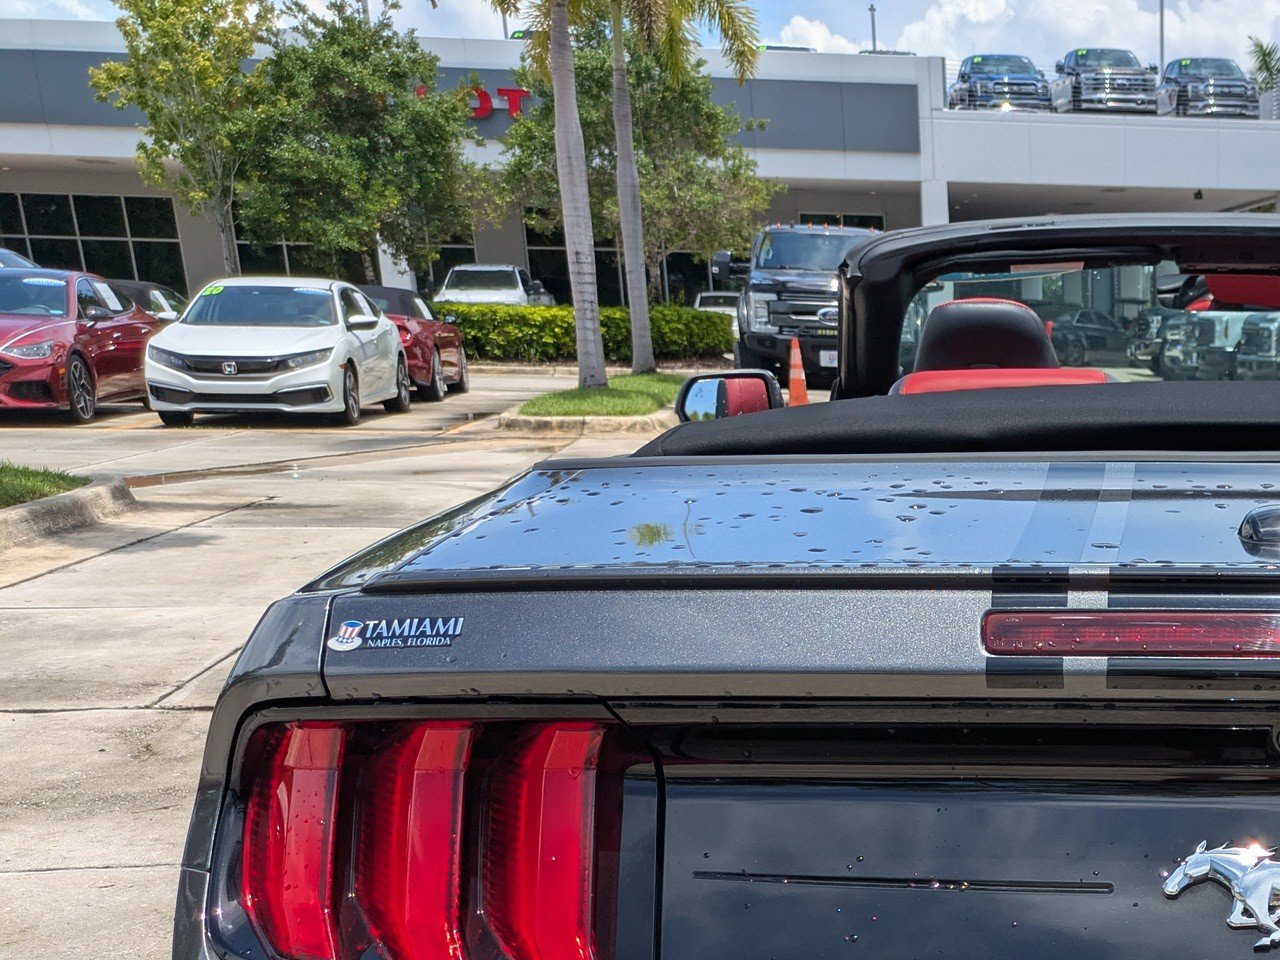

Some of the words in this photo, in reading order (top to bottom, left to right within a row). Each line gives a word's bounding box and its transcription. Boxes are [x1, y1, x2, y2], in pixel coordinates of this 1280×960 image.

[365, 617, 465, 638] TAMIAMI
[367, 637, 404, 648] NAPLES,
[407, 636, 451, 646] FLORIDA
